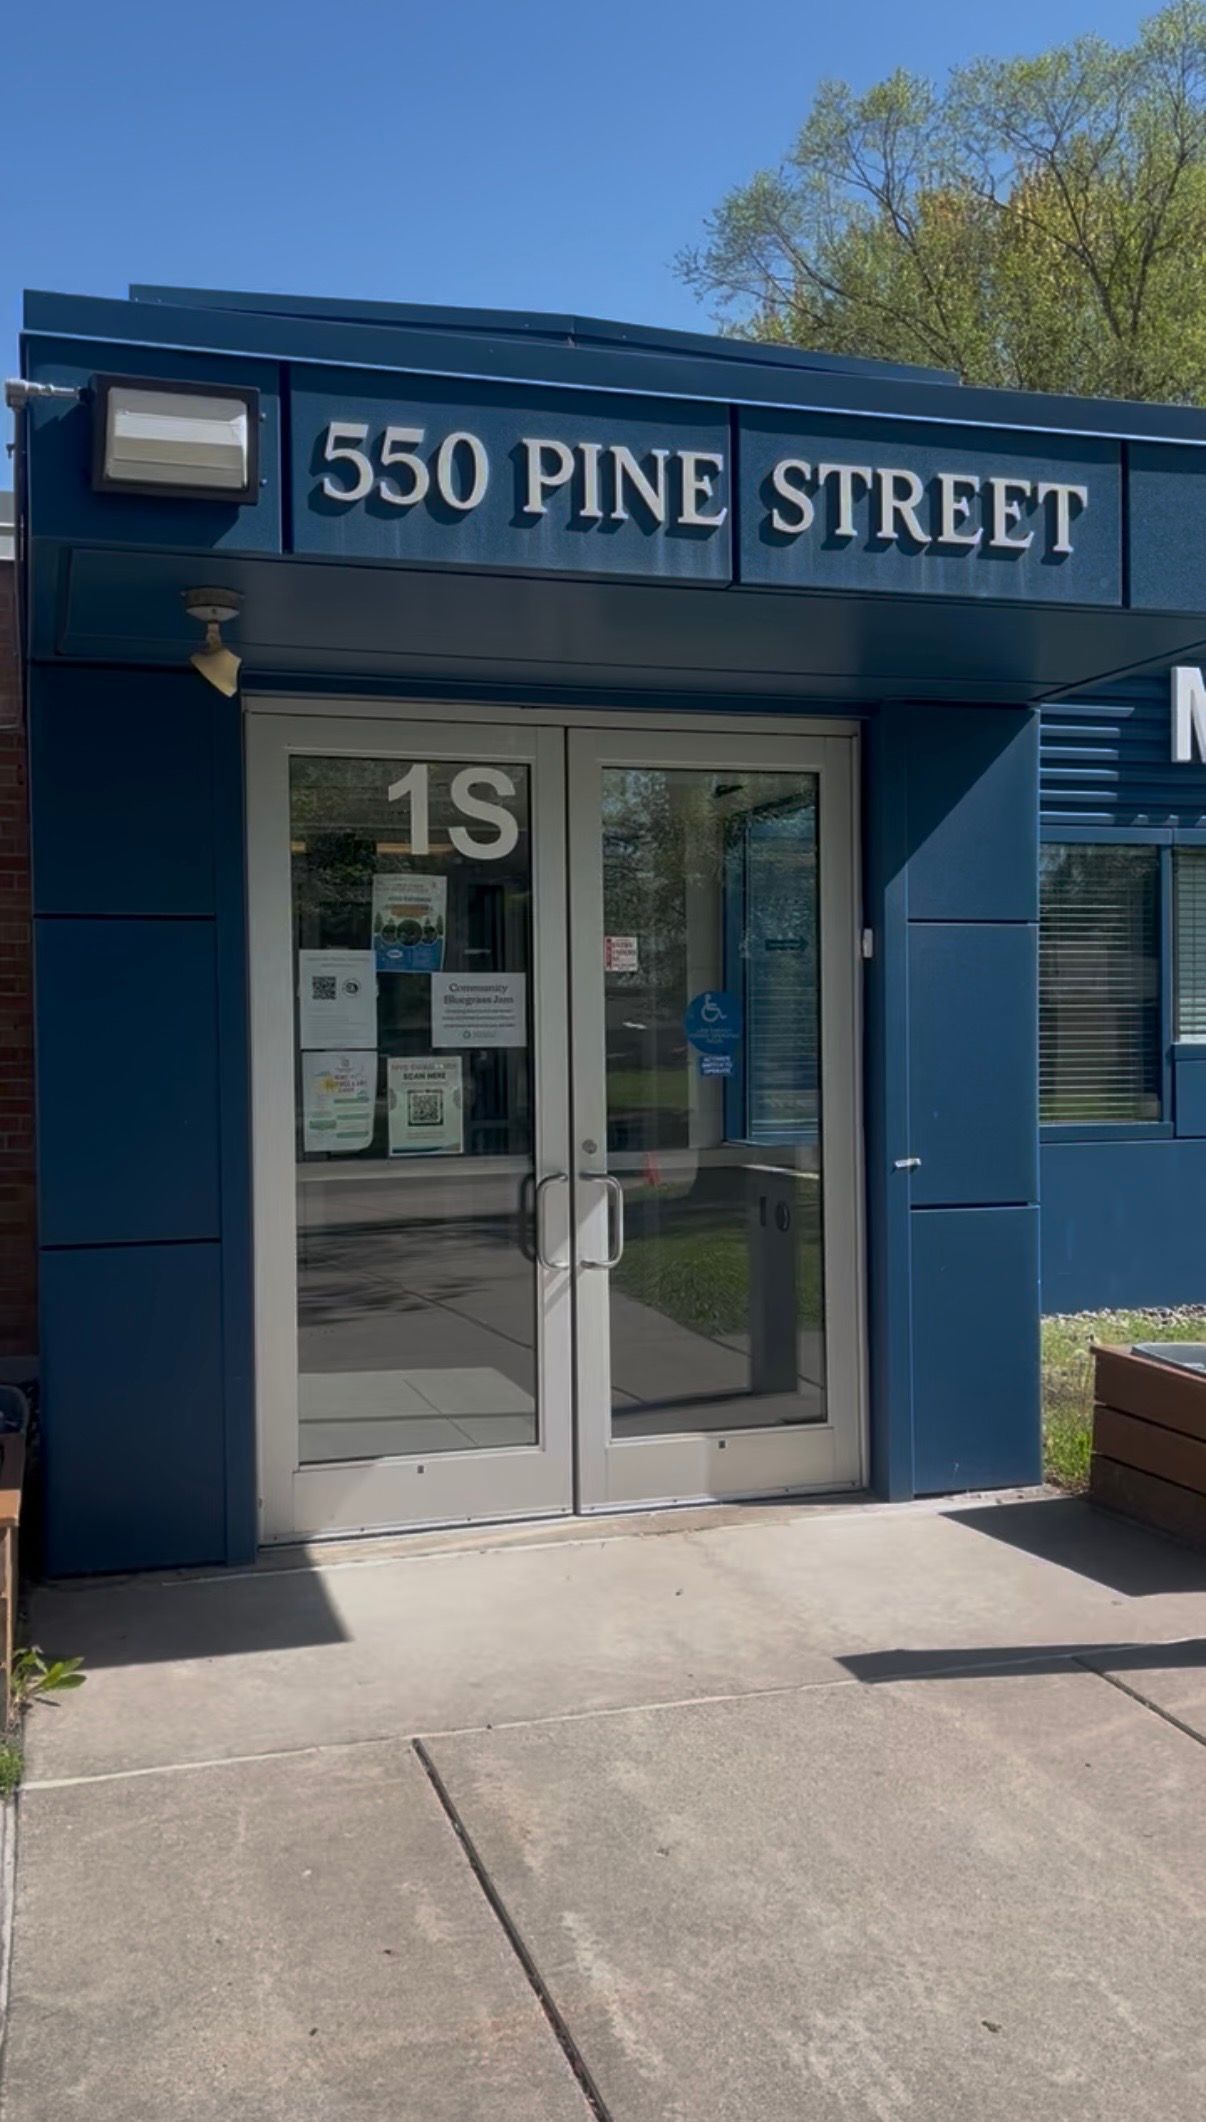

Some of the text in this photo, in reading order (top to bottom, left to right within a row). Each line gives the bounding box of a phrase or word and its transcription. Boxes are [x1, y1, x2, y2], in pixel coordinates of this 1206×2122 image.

[323, 421, 1089, 554] 550 PINE STREET
[387, 763, 519, 861] 1S
[448, 982, 508, 994] Community
[443, 995, 514, 1006] Bluegrass Jam
[403, 1072, 447, 1080] SCAN HERE
